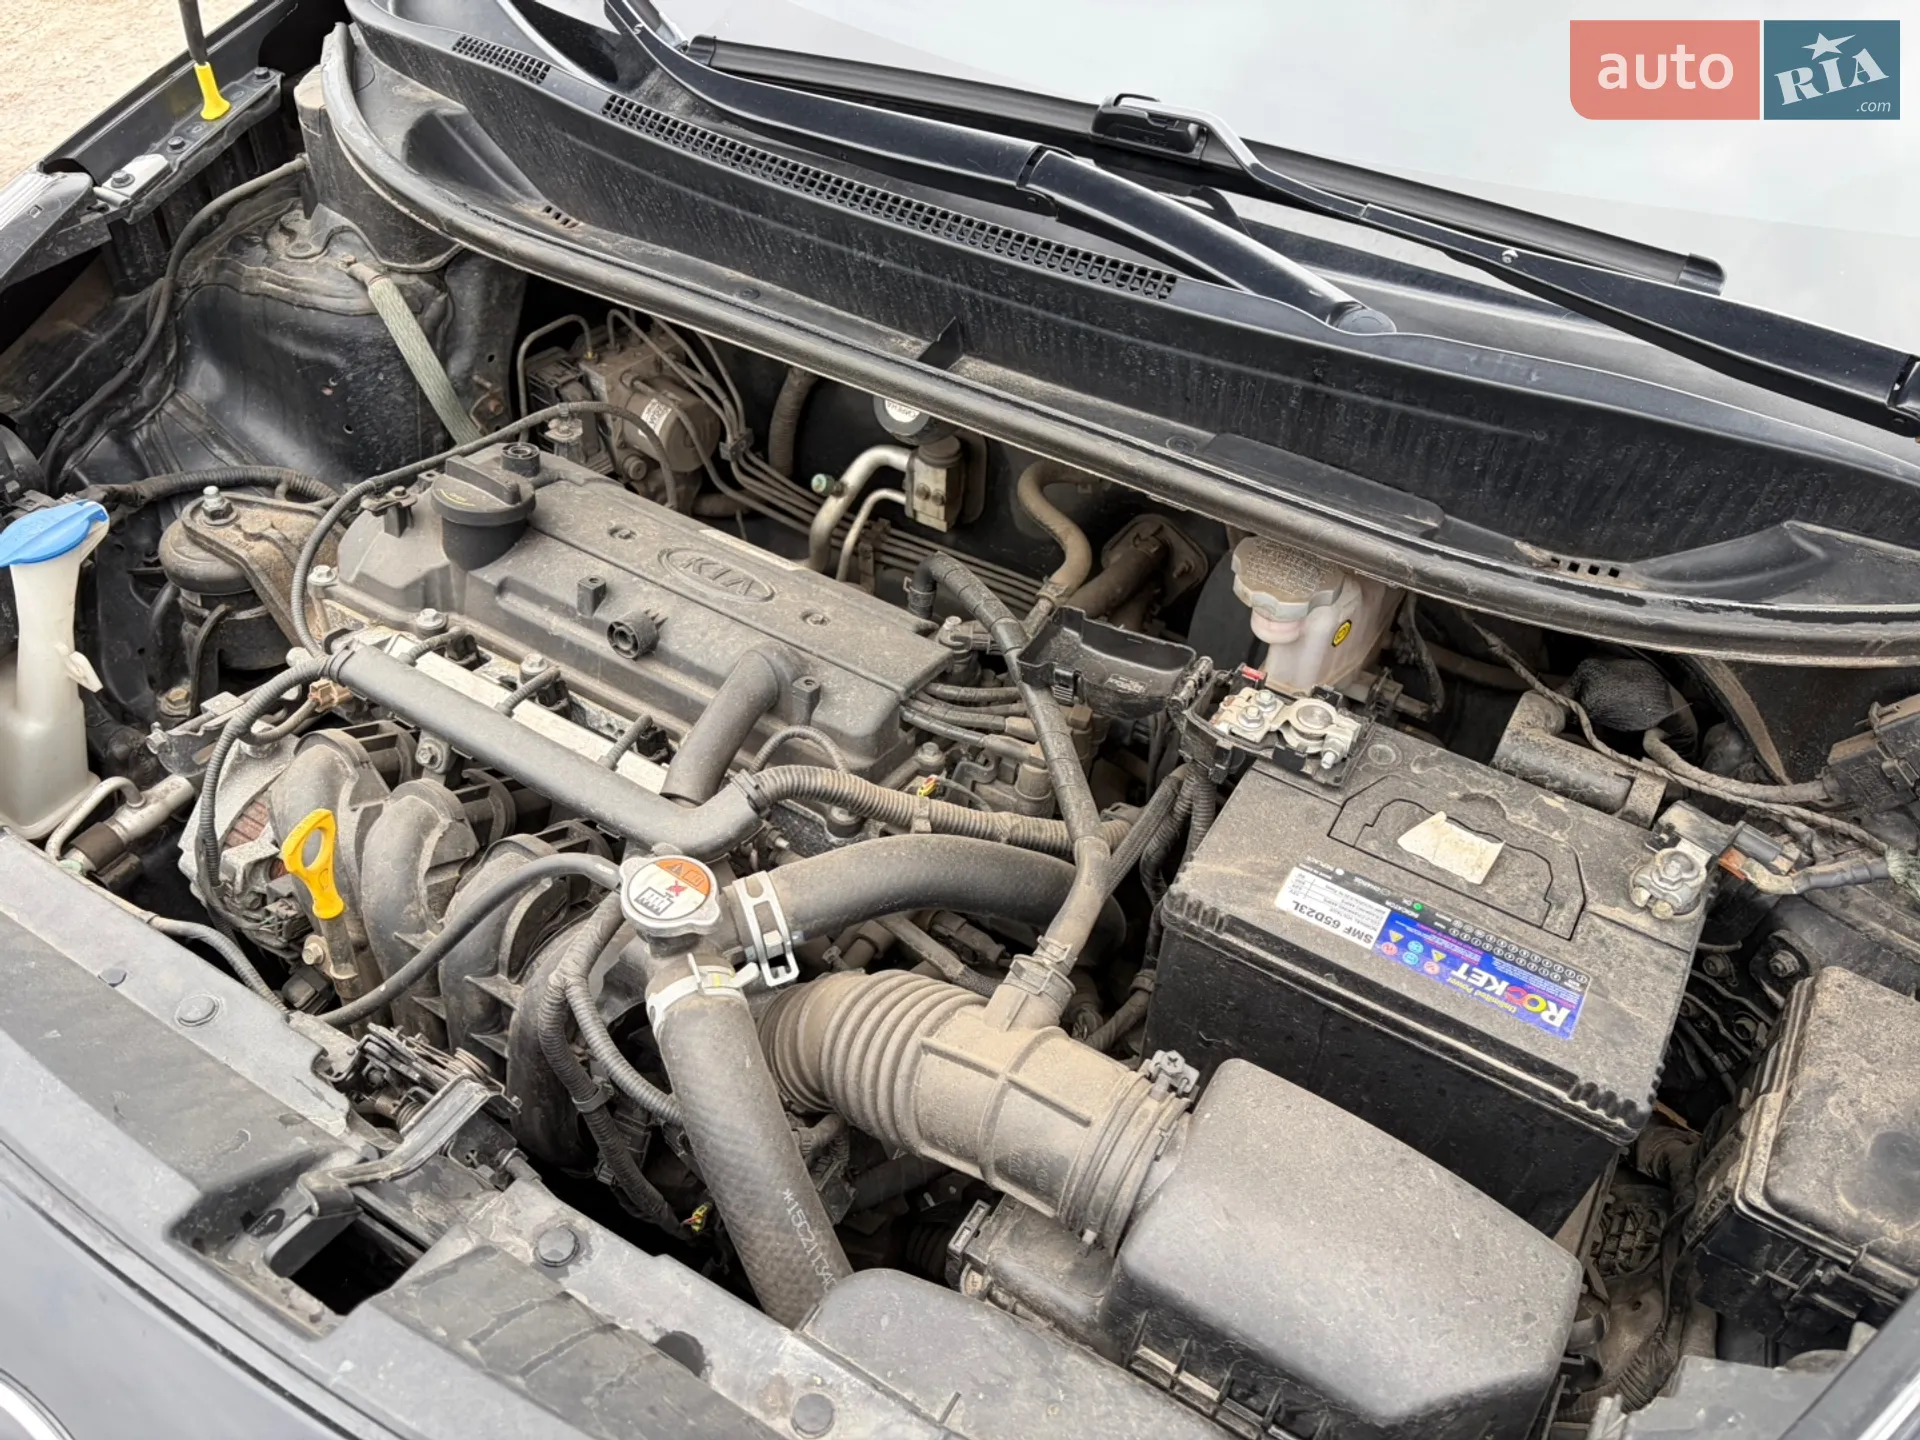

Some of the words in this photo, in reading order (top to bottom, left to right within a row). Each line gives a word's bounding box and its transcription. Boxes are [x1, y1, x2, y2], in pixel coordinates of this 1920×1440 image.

[680, 557, 756, 597] KIA
[1292, 900, 1341, 929] 65D23L
[1343, 926, 1374, 945] SMF
[1451, 962, 1571, 1028] ROCKET
